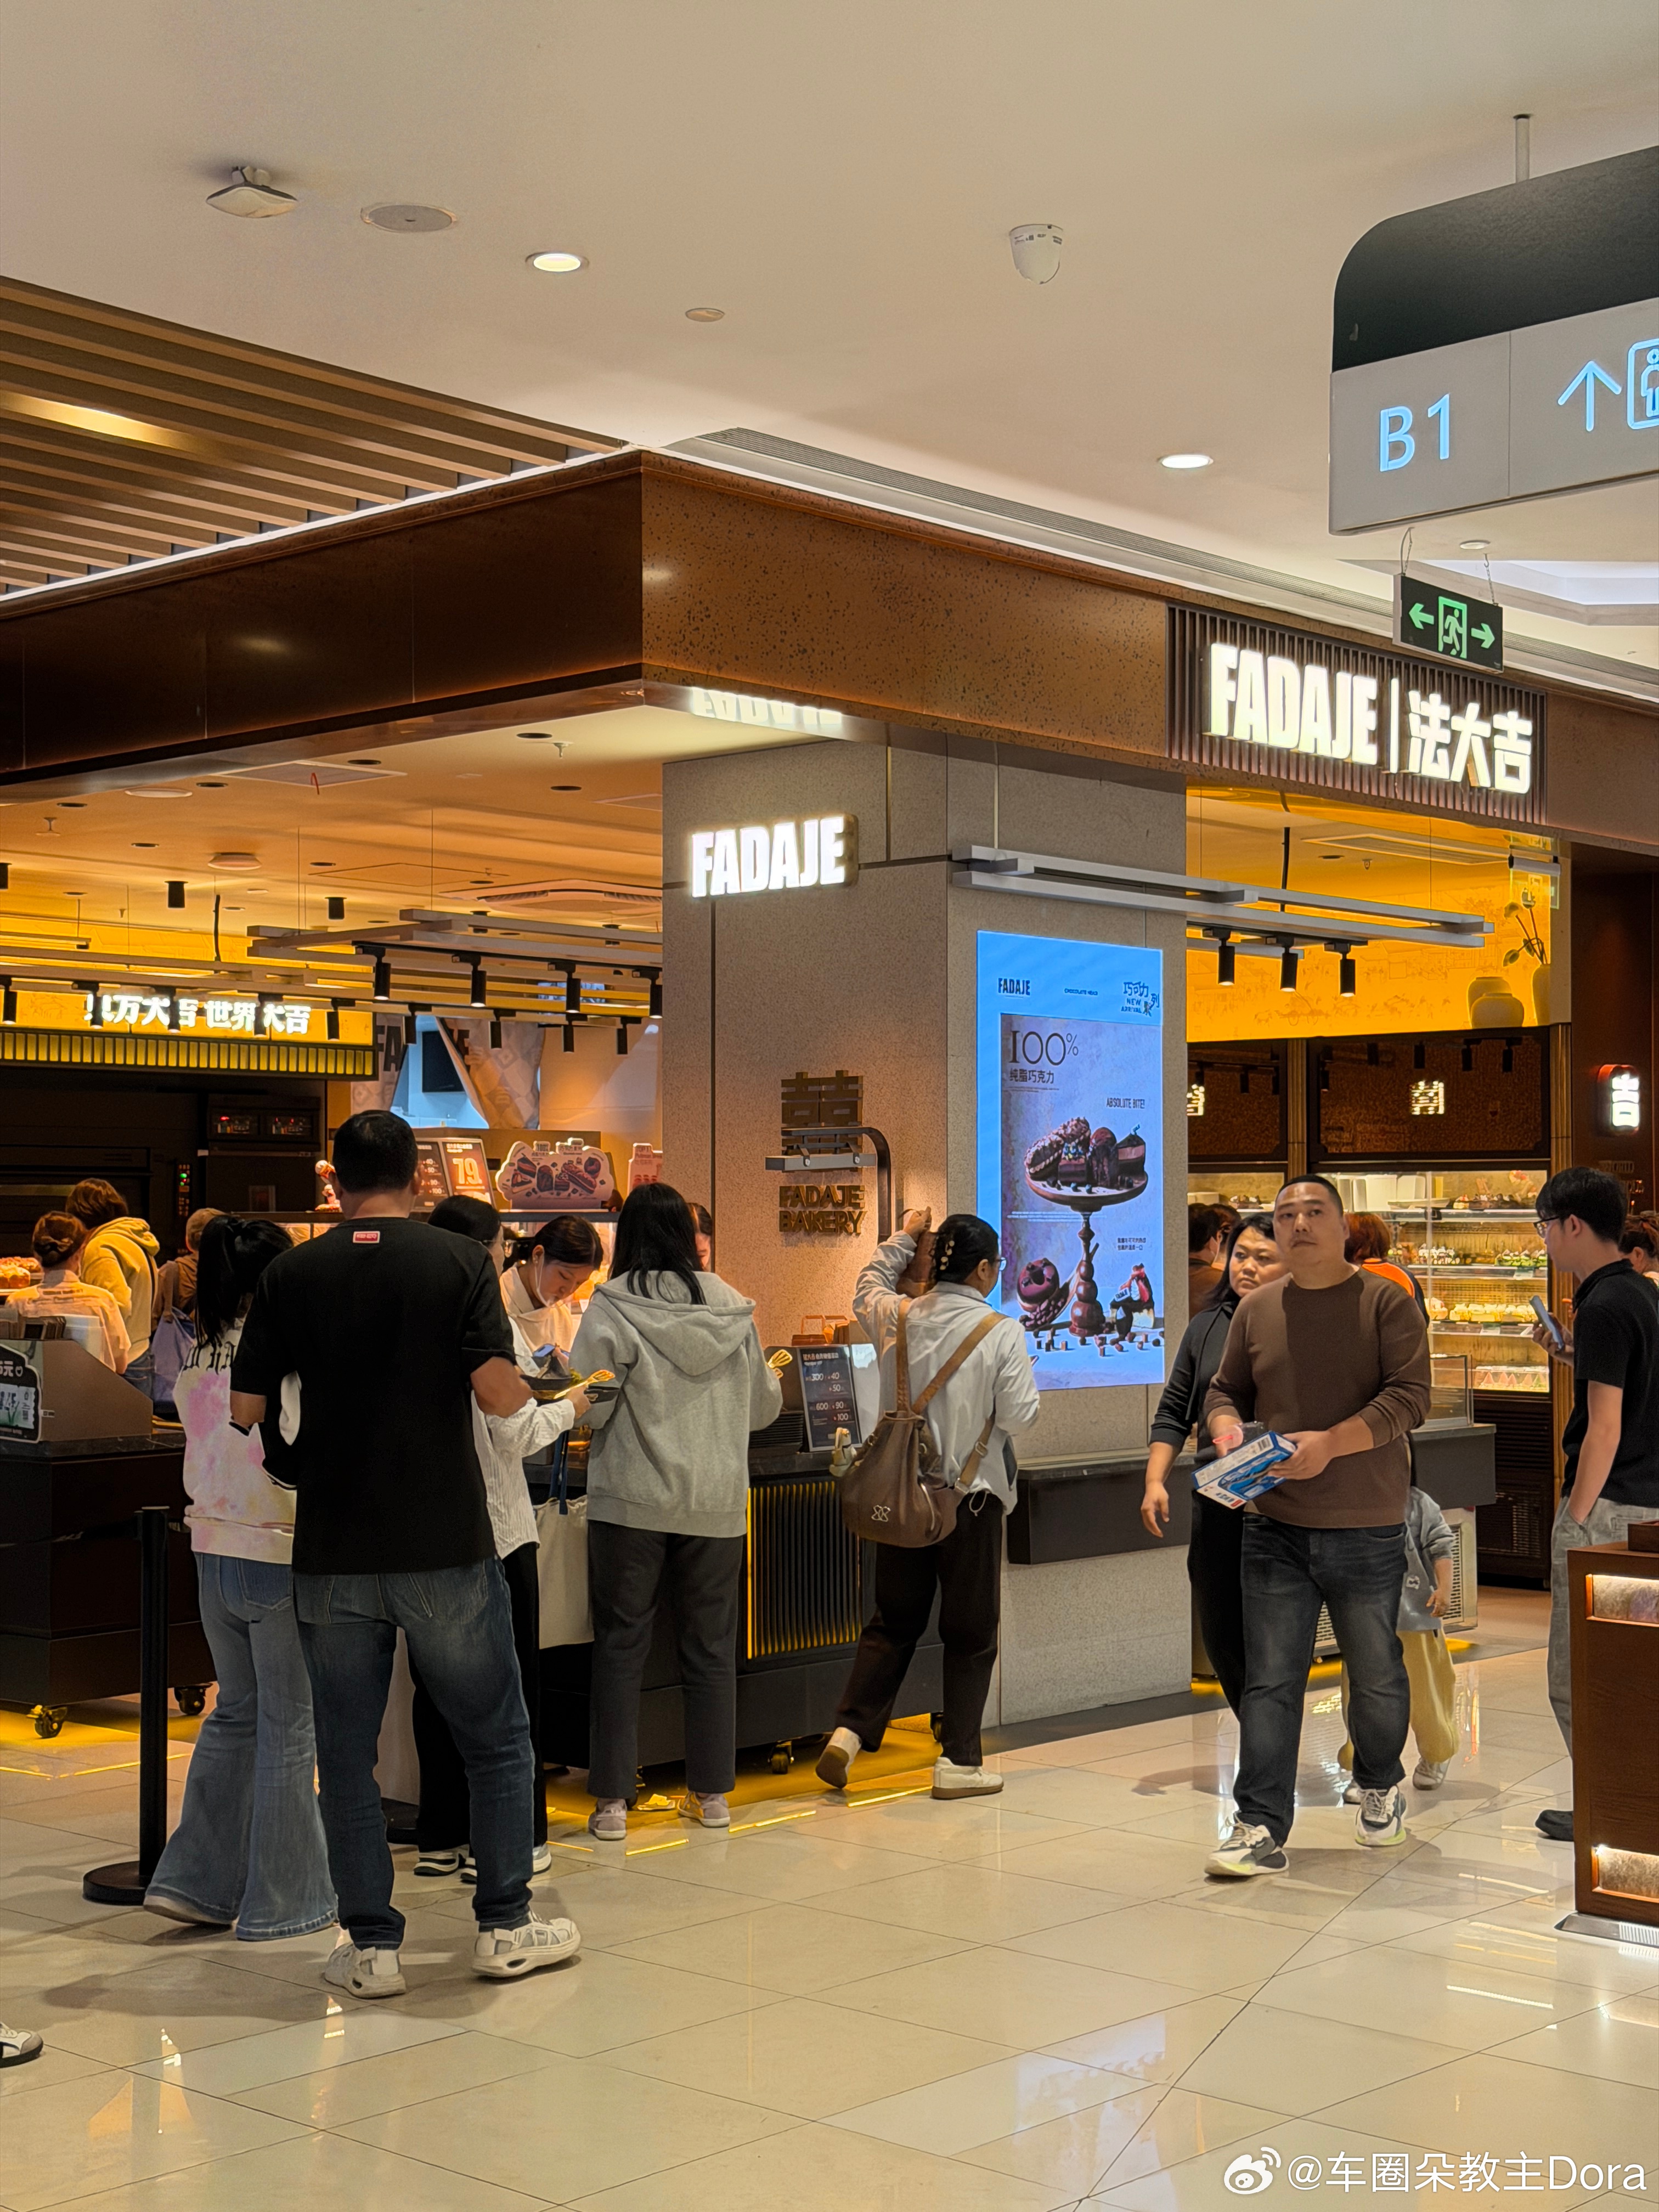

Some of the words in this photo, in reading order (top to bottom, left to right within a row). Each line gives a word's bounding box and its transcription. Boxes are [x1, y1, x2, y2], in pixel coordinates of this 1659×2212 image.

[1380, 393, 1450, 472] B1
[1210, 642, 1378, 765] FADAJE
[1408, 689, 1532, 794] 法大吉
[691, 816, 845, 898] FADAJE
[998, 978, 1030, 996] FADAJE
[1008, 1030, 1079, 1066] 100%
[1009, 1068, 1054, 1084] 纯脂巧克力
[1106, 1097, 1132, 1109] ABSOLUTE
[779, 1185, 865, 1209] FADAJE
[779, 1210, 867, 1235] BAKERY
[811, 1373, 824, 1381] 300
[837, 1413, 849, 1421] 100
